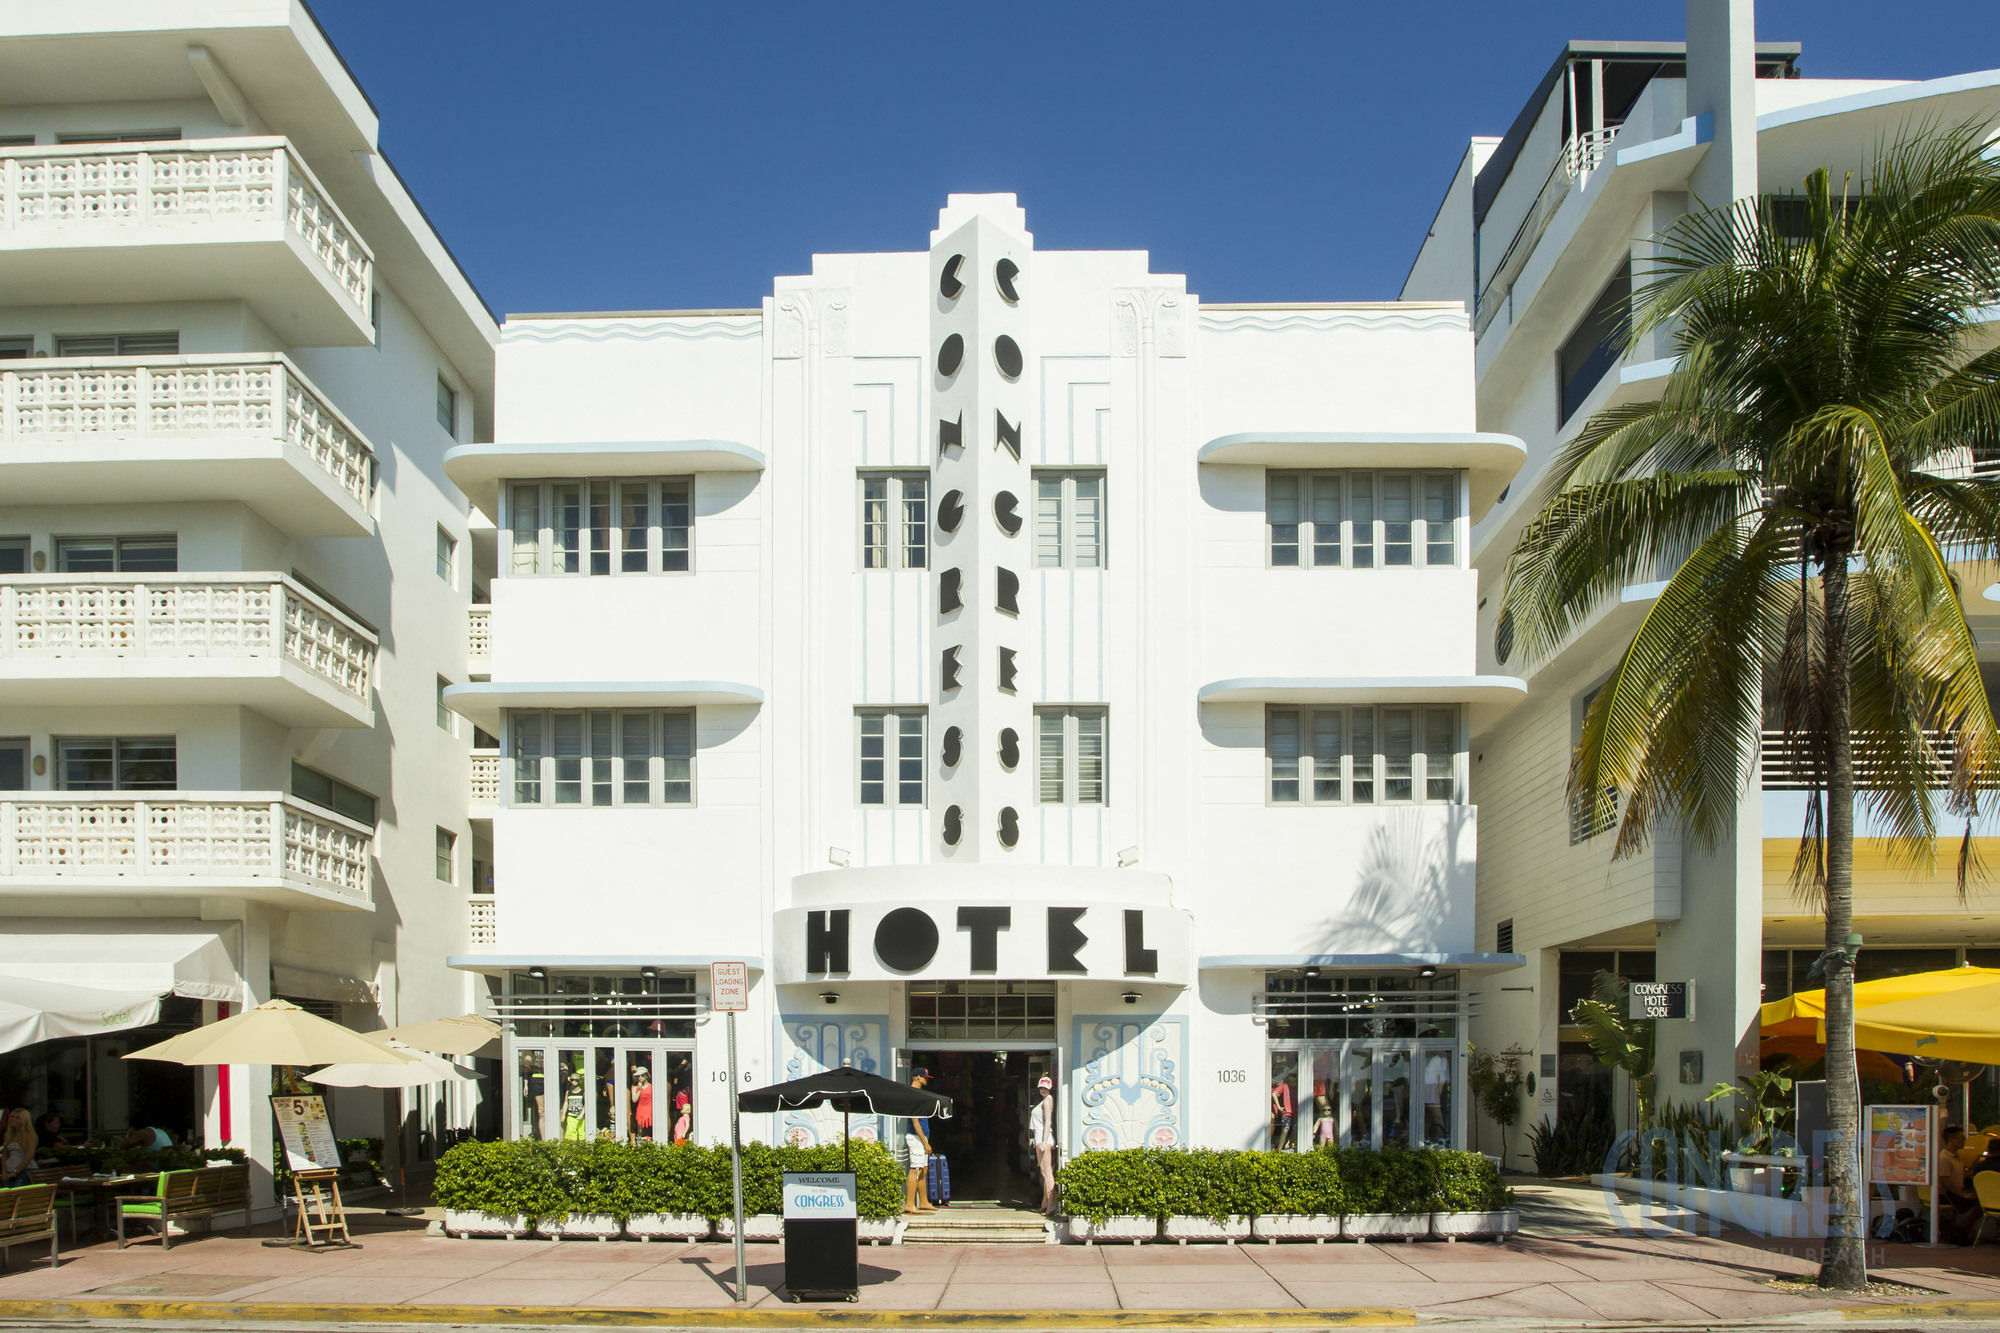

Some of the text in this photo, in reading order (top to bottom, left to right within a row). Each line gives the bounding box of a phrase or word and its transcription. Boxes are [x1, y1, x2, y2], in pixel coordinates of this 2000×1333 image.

[938, 253, 966, 848] CONGRESS
[993, 257, 1022, 849] CONGRESS
[806, 906, 1158, 974] HOTEL
[718, 968, 740, 976] GUEST
[716, 978, 744, 986] LOADING
[1634, 984, 1683, 995] CONGRESS
[1644, 995, 1672, 1006] HOTEL
[1646, 1006, 1672, 1018] SOBE
[712, 1071, 752, 1083] 106
[1217, 1070, 1246, 1083] 1036
[798, 1176, 840, 1184] WELCOME
[794, 1195, 845, 1208] CONGRESS
